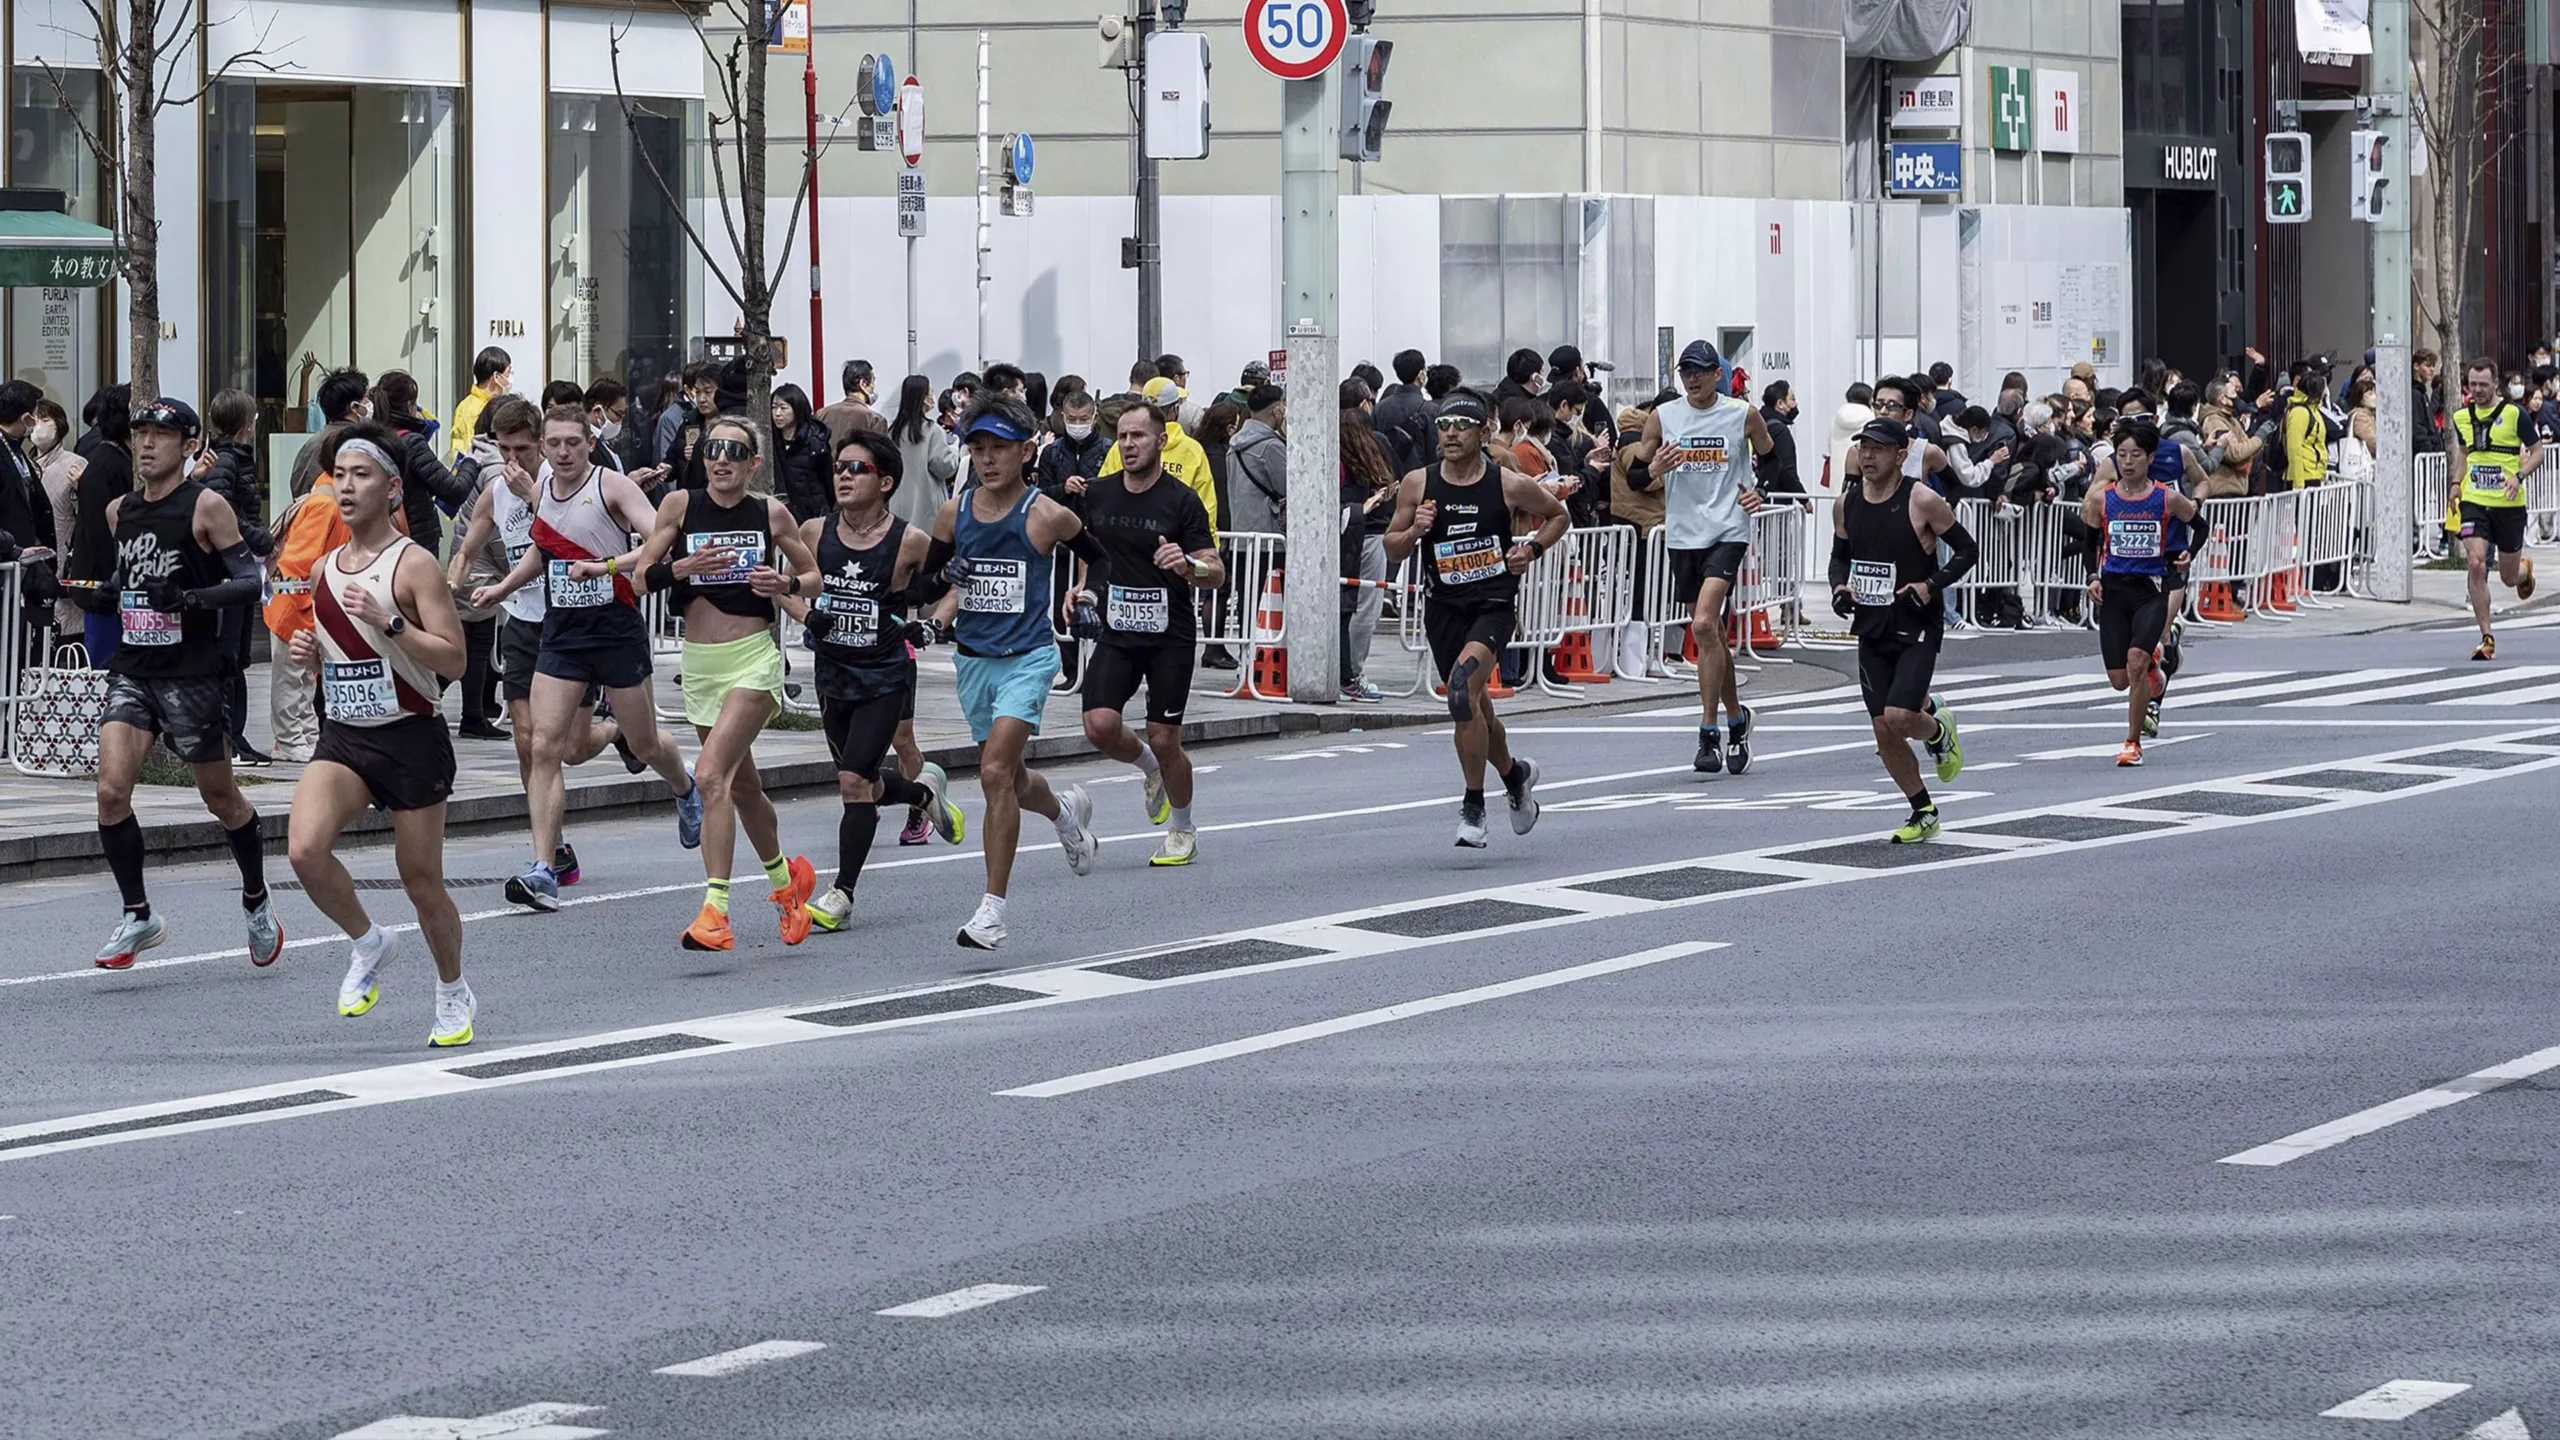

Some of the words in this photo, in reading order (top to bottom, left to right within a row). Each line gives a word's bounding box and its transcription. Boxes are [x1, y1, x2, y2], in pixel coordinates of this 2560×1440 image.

[1268, 3, 1323, 48] 50
[1920, 90, 1953, 107] 鹿島
[2165, 146, 2217, 180] HUBLOT
[43, 288, 69, 301] FURLA
[45, 304, 67, 315] EARTH
[42, 315, 70, 326] LIMITED
[42, 326, 70, 337] EDITION
[490, 320, 525, 337] FURLA
[1761, 352, 1791, 370] KAJIMA
[1686, 449, 1718, 462] 66054
[713, 535, 755, 546] 東京メトロ
[1456, 538, 1492, 552] 東京メトロ
[2120, 535, 2149, 547] 5222
[1452, 552, 1490, 572] 61002
[975, 564, 1015, 574] 東京メトロ
[1857, 565, 1889, 576] 東京メトロ
[823, 574, 879, 592] SAYSKY
[1125, 591, 1160, 600] 東京メトロ
[832, 600, 870, 612] 東京メトロ
[1119, 603, 1154, 620] 90155
[129, 611, 165, 630] 70055
[337, 666, 380, 678] 東京メトロ
[333, 683, 376, 704] 35096
